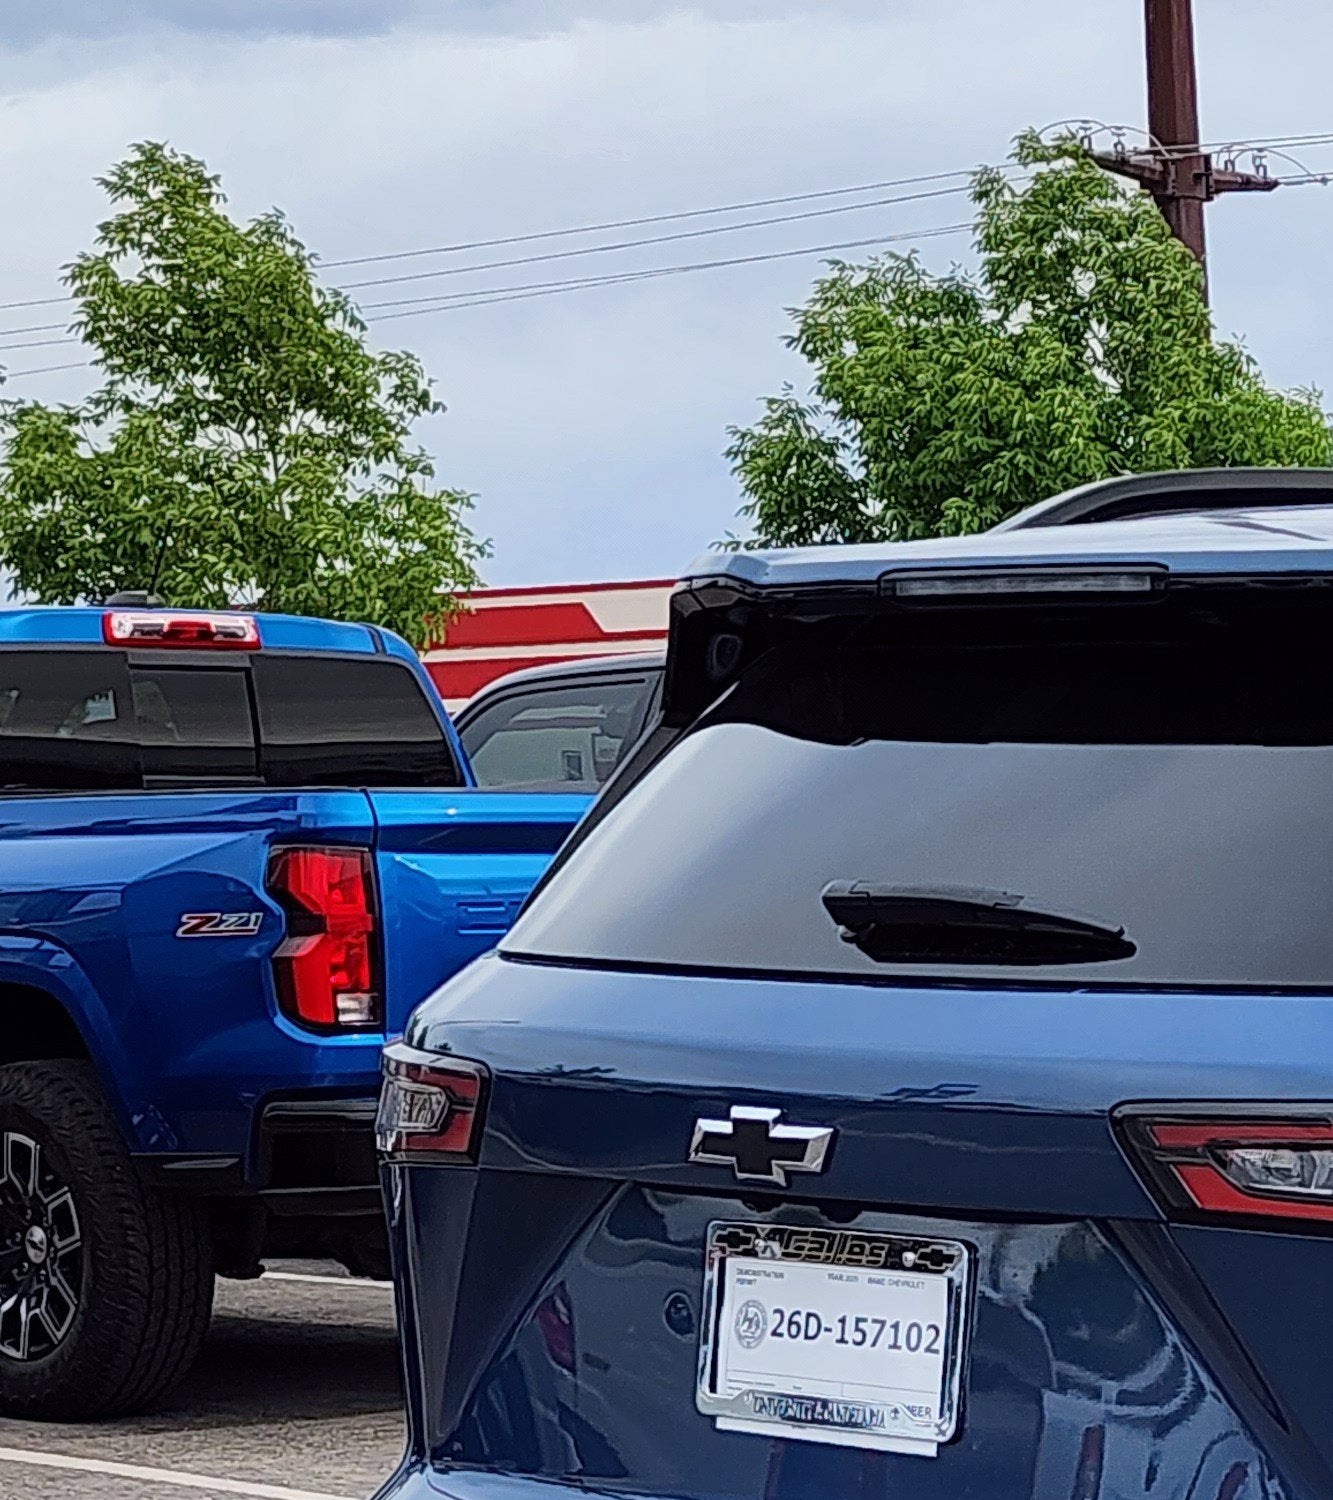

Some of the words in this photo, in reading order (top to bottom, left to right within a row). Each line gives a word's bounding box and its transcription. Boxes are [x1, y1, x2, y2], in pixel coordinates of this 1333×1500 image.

[176, 912, 263, 937] Z71
[782, 1230, 889, 1266] Galles
[770, 1307, 940, 1355] 26D-157102
